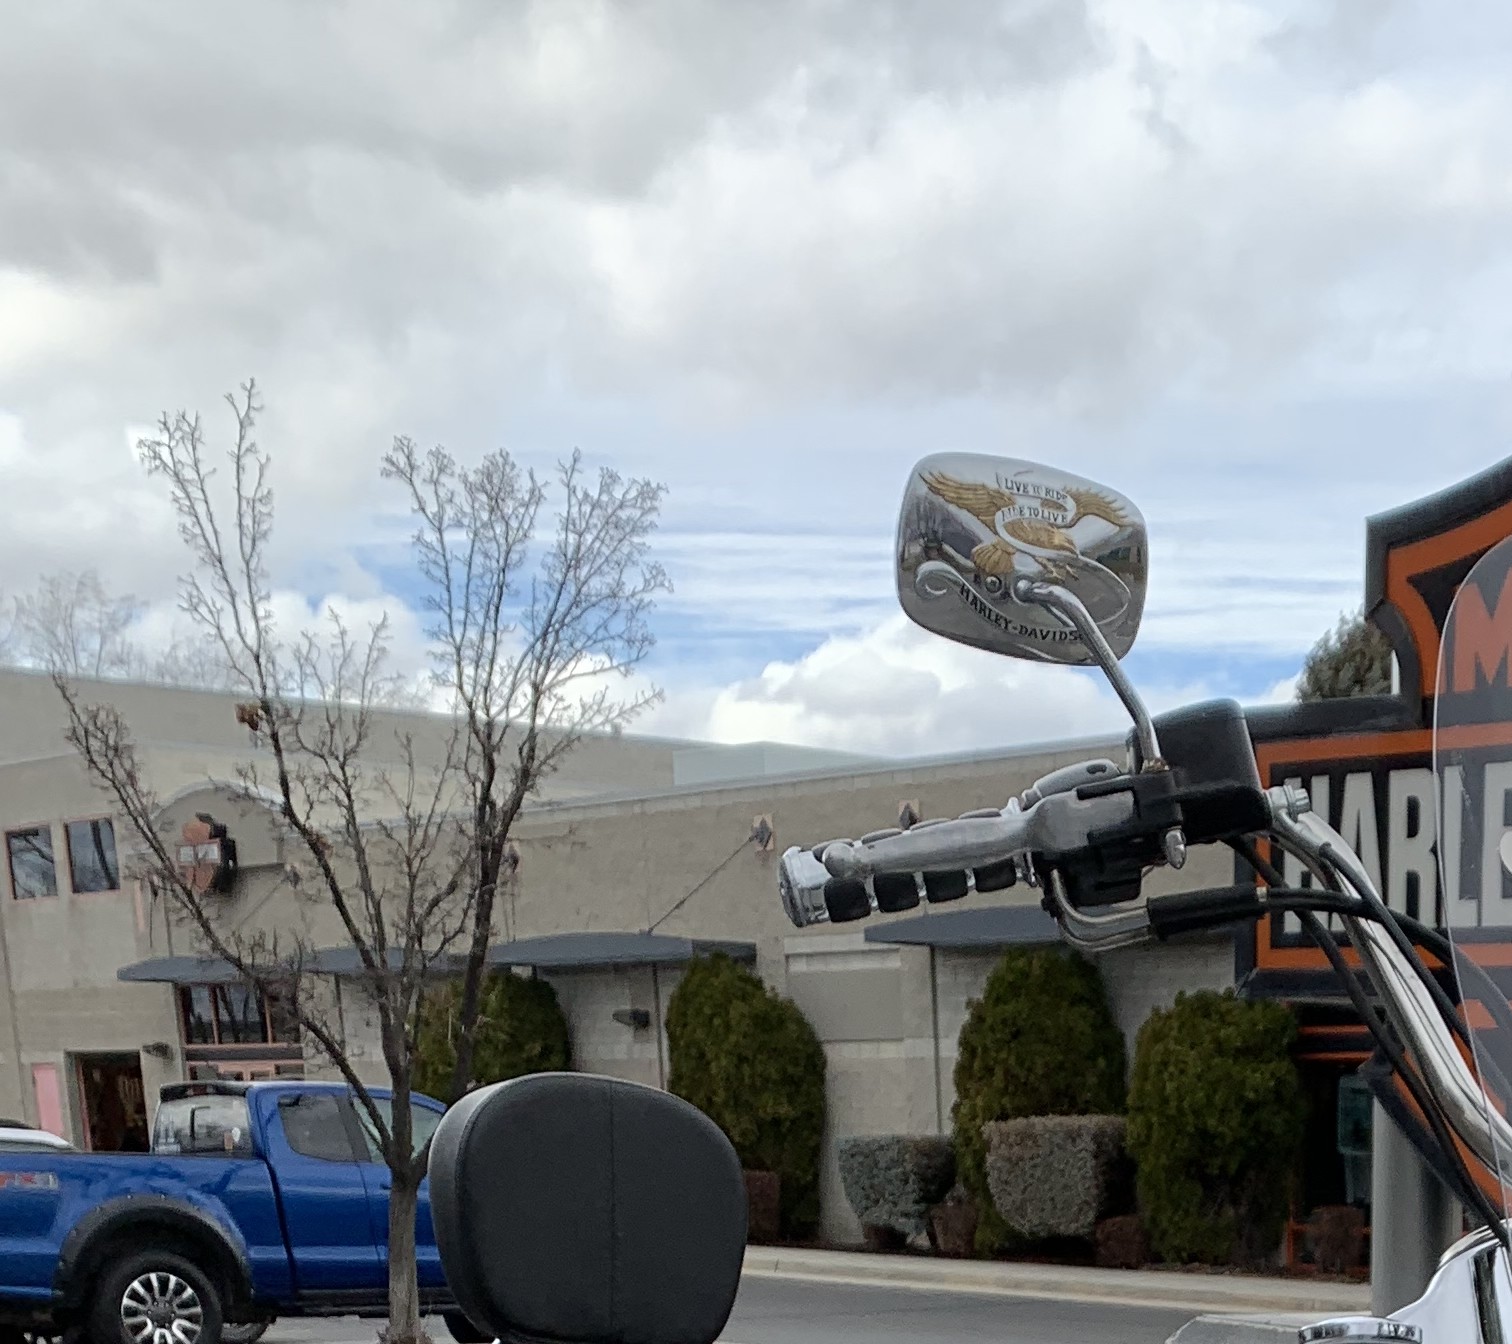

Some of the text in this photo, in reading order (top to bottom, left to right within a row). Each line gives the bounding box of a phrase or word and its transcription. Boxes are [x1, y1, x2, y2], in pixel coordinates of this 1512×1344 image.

[1004, 478, 1029, 493] LIVE
[1027, 506, 1040, 518] TO
[1041, 509, 1069, 523] LIVE
